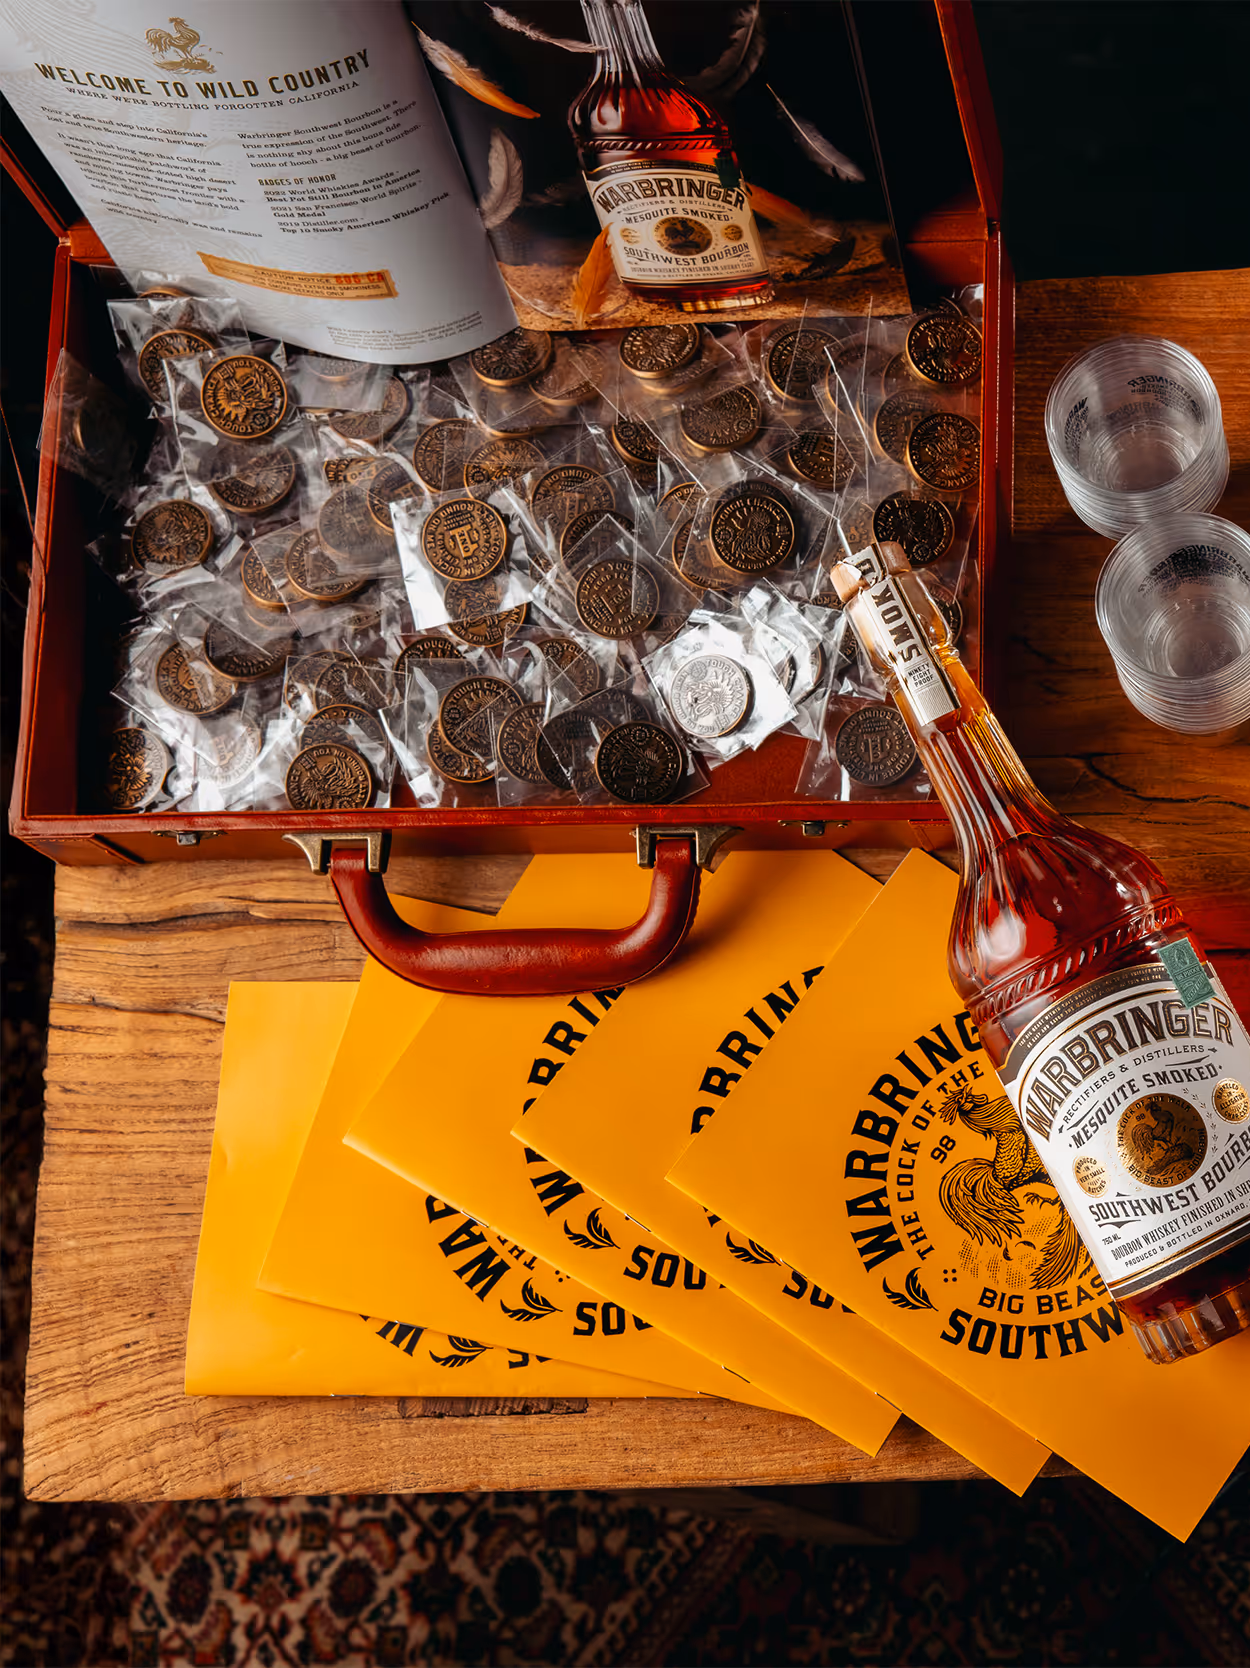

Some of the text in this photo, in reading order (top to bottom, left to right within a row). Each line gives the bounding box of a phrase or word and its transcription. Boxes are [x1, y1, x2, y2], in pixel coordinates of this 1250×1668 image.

[34, 48, 370, 99] WELCOME TO WILD COUNTRY
[65, 81, 359, 110] WHERE WE'RE BOTTLING FORGOTTEN CALIFORNIA
[258, 178, 292, 186] BADGES
[308, 174, 337, 184] HONOR
[288, 188, 316, 196] World
[318, 182, 360, 194] Whiskies
[362, 172, 394, 186] Awards
[308, 194, 330, 202] Still
[331, 187, 371, 198] Bourbon
[384, 168, 420, 186] America
[314, 200, 358, 211] Francisco
[360, 192, 387, 204] World
[388, 182, 417, 196] Spirits
[596, 177, 745, 214] WARBRINGER
[302, 217, 358, 226] Distiller.com
[346, 217, 391, 230] American
[392, 201, 430, 220] Whiskey
[430, 192, 450, 205] Pick
[625, 207, 730, 224] MESQUITE SMOKED
[623, 242, 750, 266] SOUTHWEST BOURBON
[428, 516, 440, 533] ON
[440, 503, 474, 518] ROUND
[426, 534, 435, 550] ME
[436, 558, 461, 576] LUCK
[464, 567, 475, 576] IN
[856, 557, 923, 664] SMOKD
[907, 662, 930, 678] NINETY
[912, 668, 932, 682] EIGHT
[914, 674, 934, 688] PROOF
[706, 658, 744, 719] TOUGH CHANCE
[1026, 1000, 1234, 1141] WARBRINGER
[1062, 1044, 1205, 1124] RECTIFIERS & DISTILLERS
[1071, 1062, 1220, 1150] MESQUITE SMOKED
[1120, 1106, 1136, 1130] COCK
[1135, 1100, 1146, 1110] OF
[1136, 1112, 1146, 1122] 98
[843, 1010, 985, 1273] WARBRING
[929, 1134, 958, 1164] 98
[896, 1060, 985, 1261] THE COCK OF THE
[1076, 1158, 1098, 1174] PRODUCED
[1090, 1168, 1106, 1178] SMALL
[1128, 1164, 1143, 1178] BIG
[1144, 1174, 1174, 1185] BEAST
[1176, 1170, 1188, 1180] OF
[1088, 1184, 1200, 1223] SOUTHWEST
[1102, 1233, 1122, 1246] 750 ML
[1111, 1238, 1142, 1261] BOURBON
[1141, 1220, 1182, 1246] WHISKEY
[1181, 1196, 1228, 1228] FINISHED
[1226, 1189, 1236, 1204] IN
[1124, 1249, 1159, 1268] PRODUCED
[1166, 1225, 1204, 1248] BOTTLED
[1204, 1220, 1214, 1229] IN
[1214, 1200, 1249, 1223] OXNARD,
[977, 1286, 1025, 1315] BIG
[940, 1300, 1125, 1360] SOUTHW
